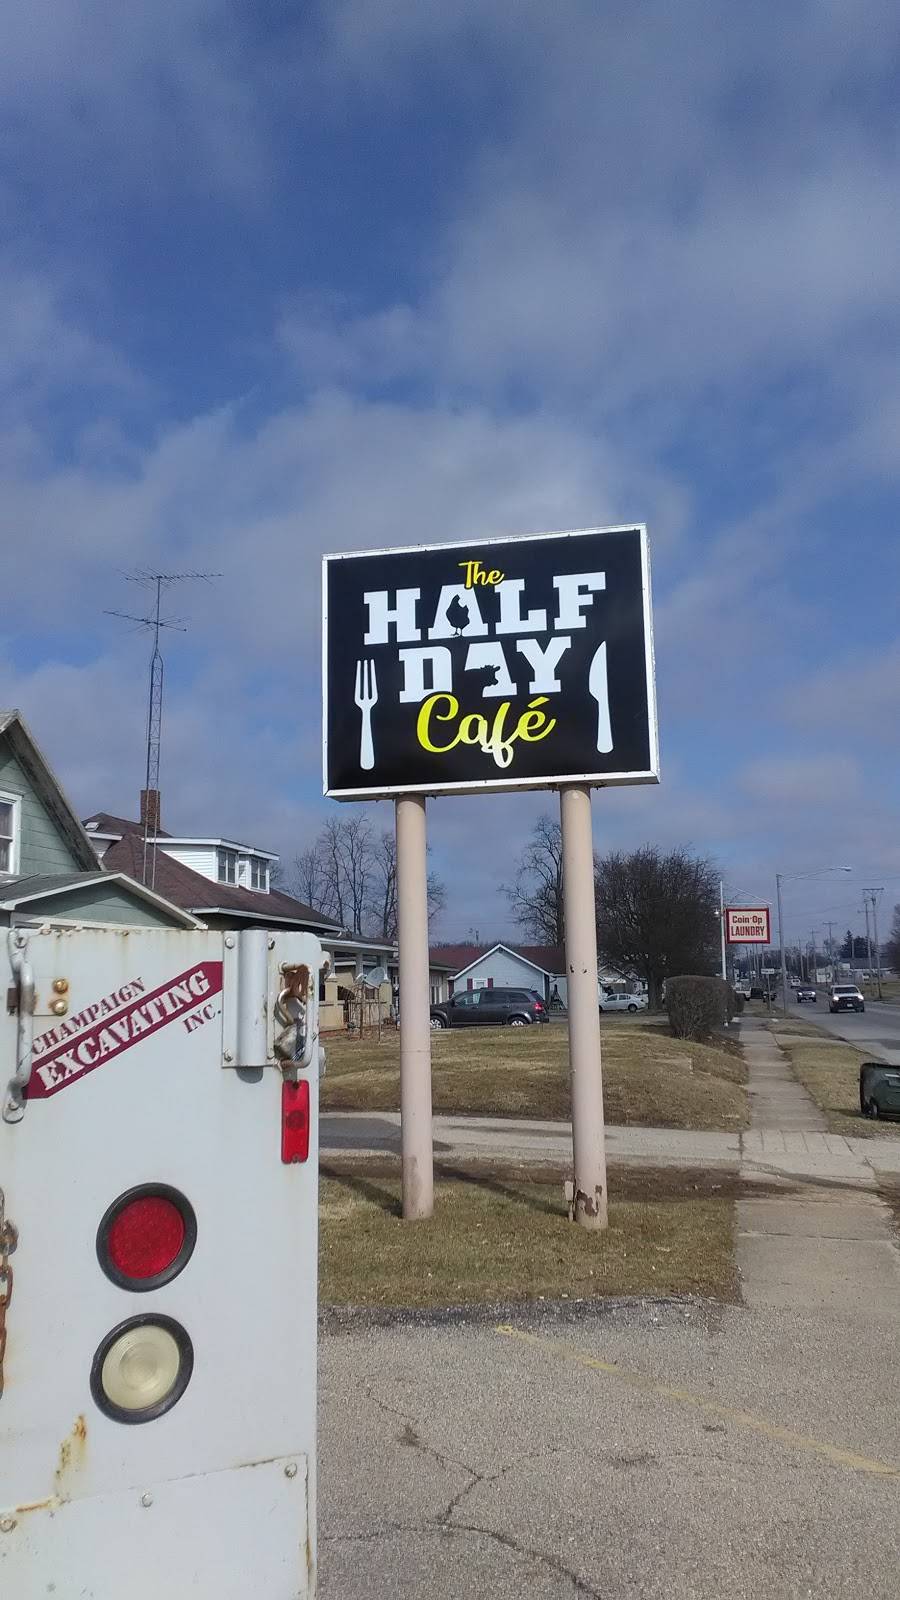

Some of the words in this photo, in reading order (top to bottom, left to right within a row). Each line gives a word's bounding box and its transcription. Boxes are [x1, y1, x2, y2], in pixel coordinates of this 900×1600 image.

[363, 572, 606, 645] HALF
[458, 561, 504, 588] The
[399, 636, 571, 703] DAY
[417, 693, 556, 768] Café
[731, 926, 764, 936] LAUNDRY
[32, 977, 146, 1055] CHAMPAIGN
[36, 970, 210, 1091] EXCAVATING
[182, 1003, 222, 1034] INC.
